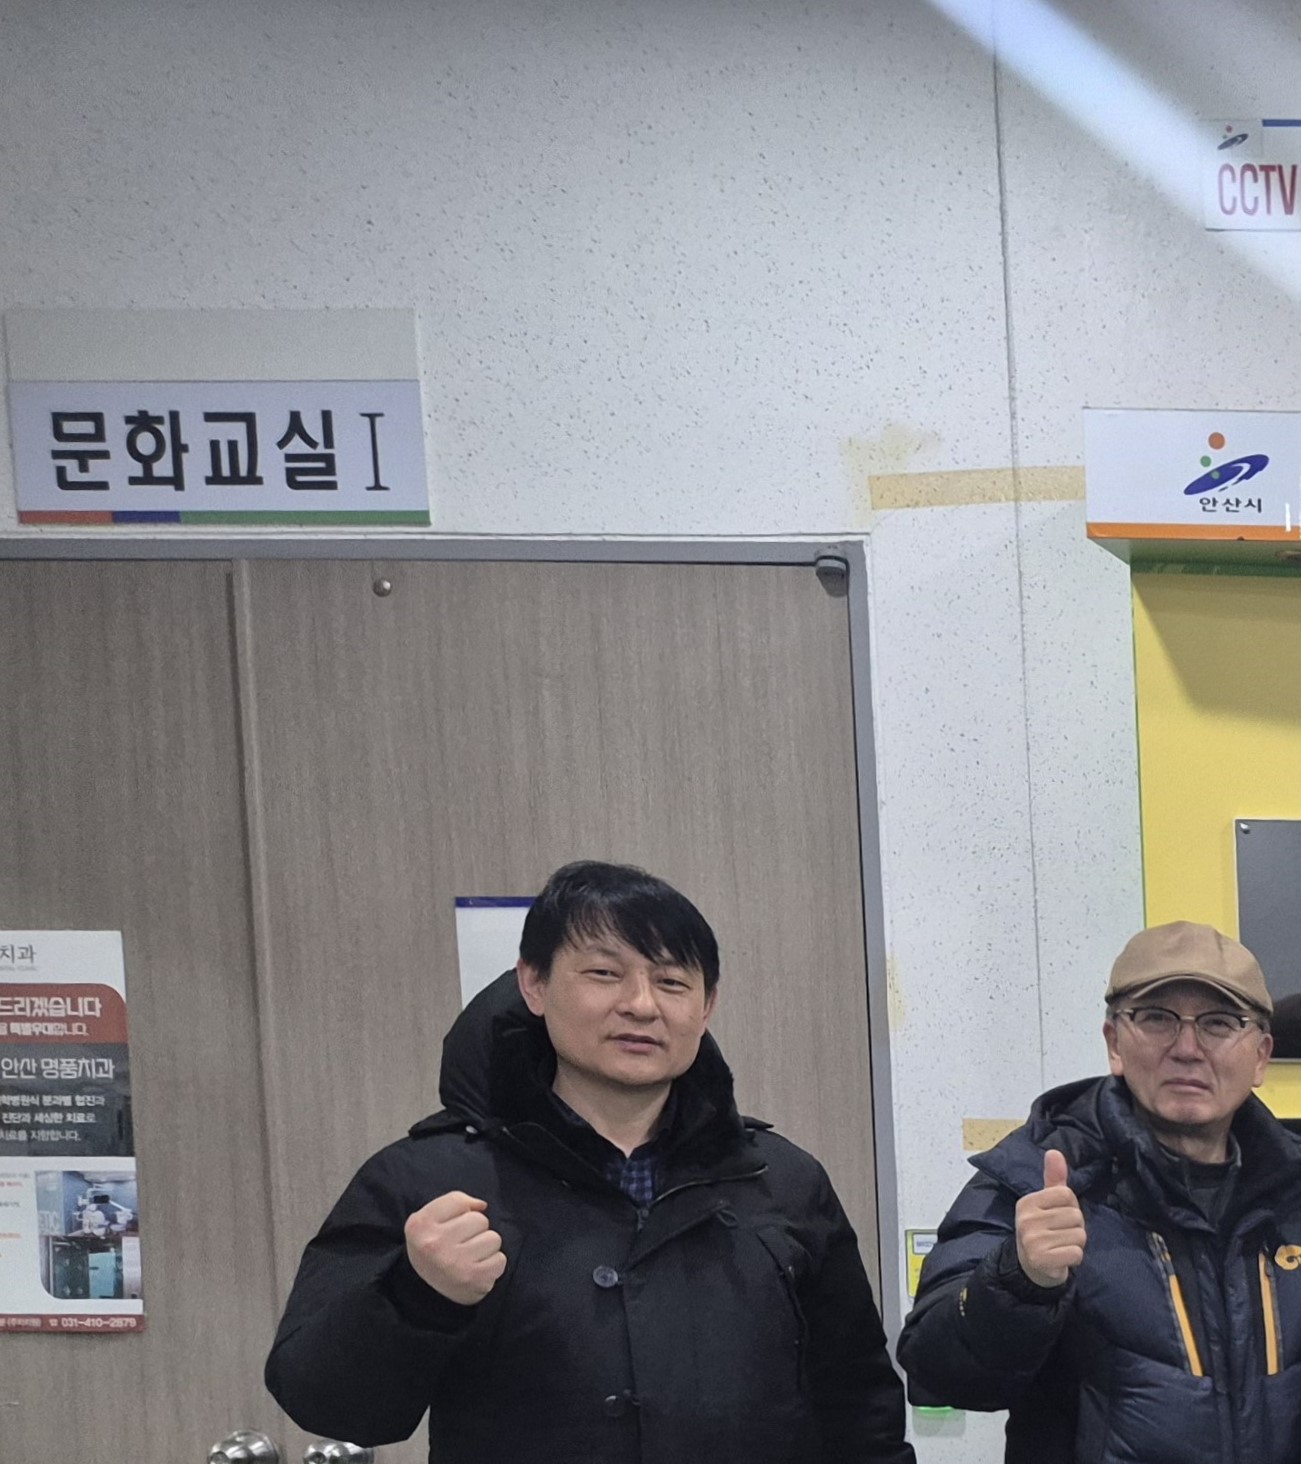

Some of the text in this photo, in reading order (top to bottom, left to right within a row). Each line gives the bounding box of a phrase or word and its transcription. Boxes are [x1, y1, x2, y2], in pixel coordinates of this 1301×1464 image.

[50, 409, 339, 492] 문화교실
[1198, 496, 1264, 515] 안산시
[1, 1058, 115, 1079] 안산 명품치과
